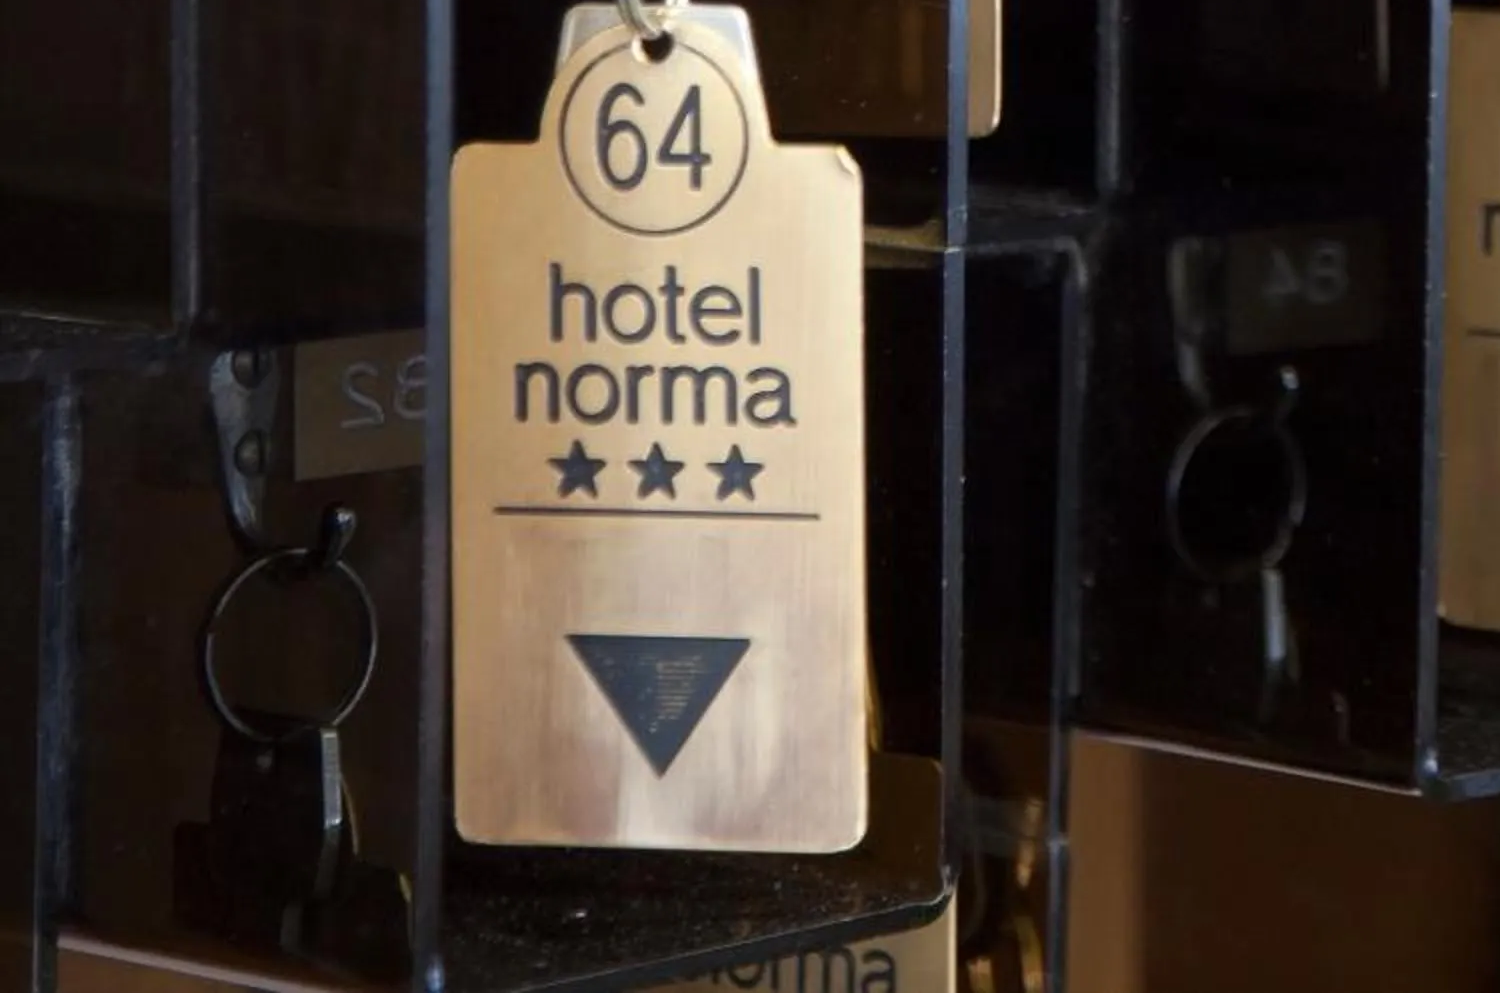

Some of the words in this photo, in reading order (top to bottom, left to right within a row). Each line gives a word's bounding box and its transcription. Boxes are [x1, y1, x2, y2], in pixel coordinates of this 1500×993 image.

[596, 82, 711, 191] 64
[549, 262, 761, 344] hotel
[515, 361, 798, 426] norma
[711, 947, 896, 993] orma
